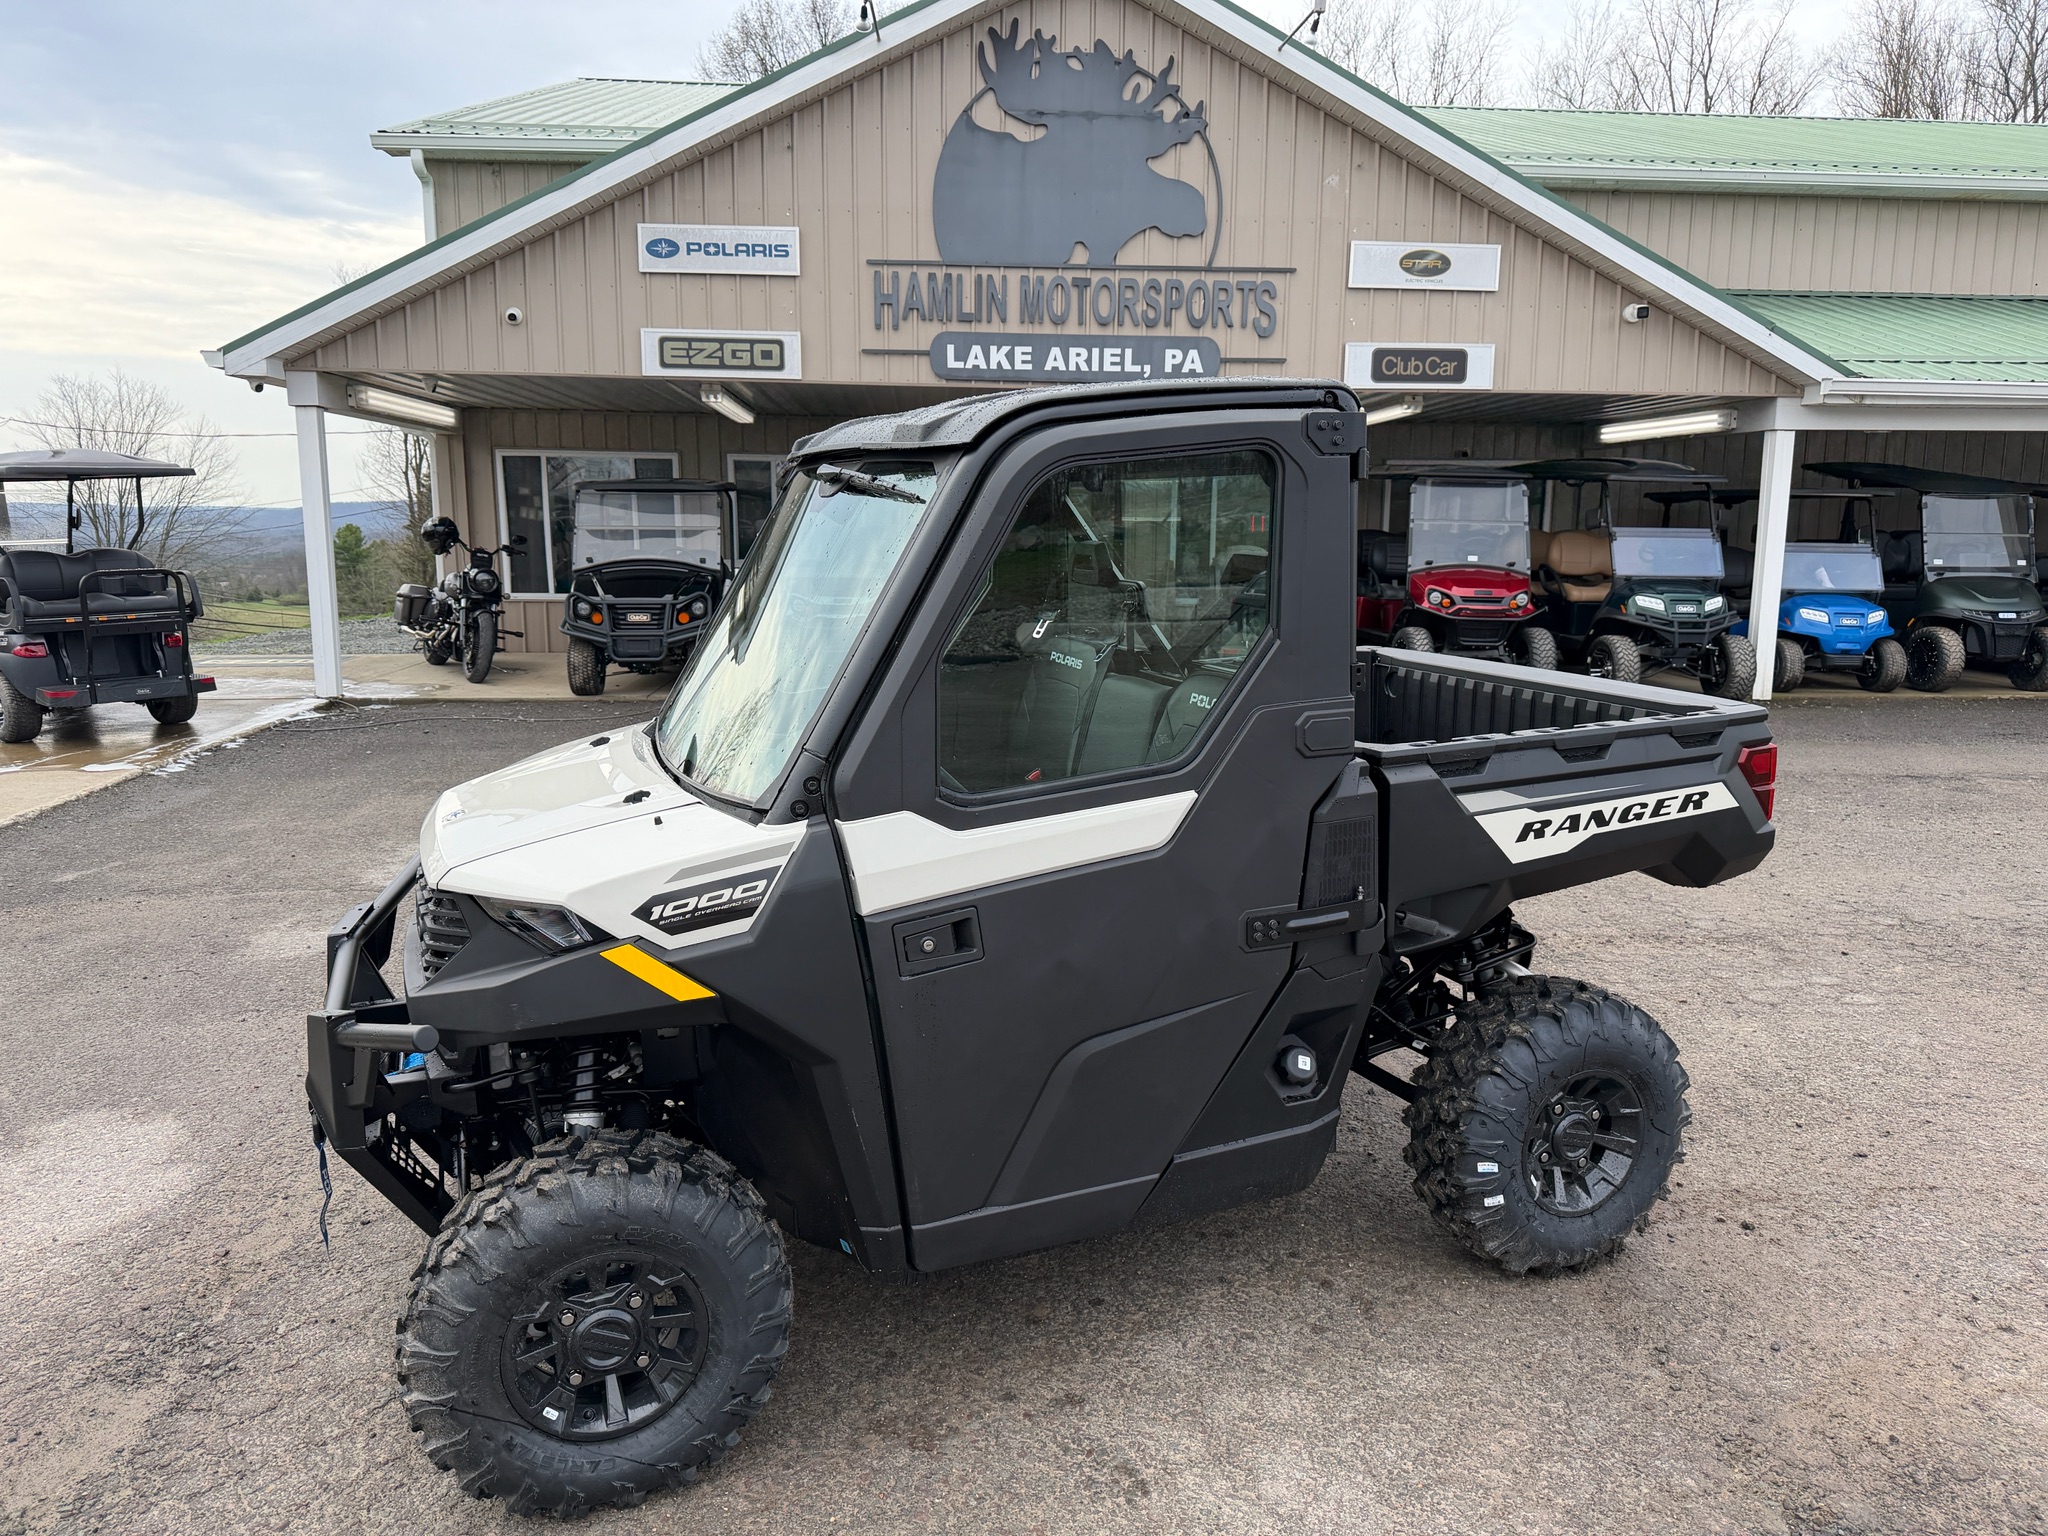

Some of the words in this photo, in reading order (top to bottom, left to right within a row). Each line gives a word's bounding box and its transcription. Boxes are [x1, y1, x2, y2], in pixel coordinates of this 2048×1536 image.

[686, 242, 790, 258] POLARIS
[1401, 259, 1442, 269] STAR
[873, 270, 1008, 330] HAMLIN
[1019, 275, 1278, 338] MOTORSPORTS
[663, 341, 781, 367] EZGO
[946, 344, 1033, 370] LAKE
[1044, 346, 1151, 378] ARIEL,
[1164, 348, 1204, 373] PA
[1382, 356, 1423, 376] Club
[1425, 356, 1458, 376] Car
[1050, 651, 1083, 670] POLARIS
[1514, 790, 1710, 843] RANGER
[649, 879, 768, 921] 1000
[658, 913, 692, 925] SINGLE
[694, 901, 741, 916] OVERHEAD
[742, 896, 763, 904] CAM
